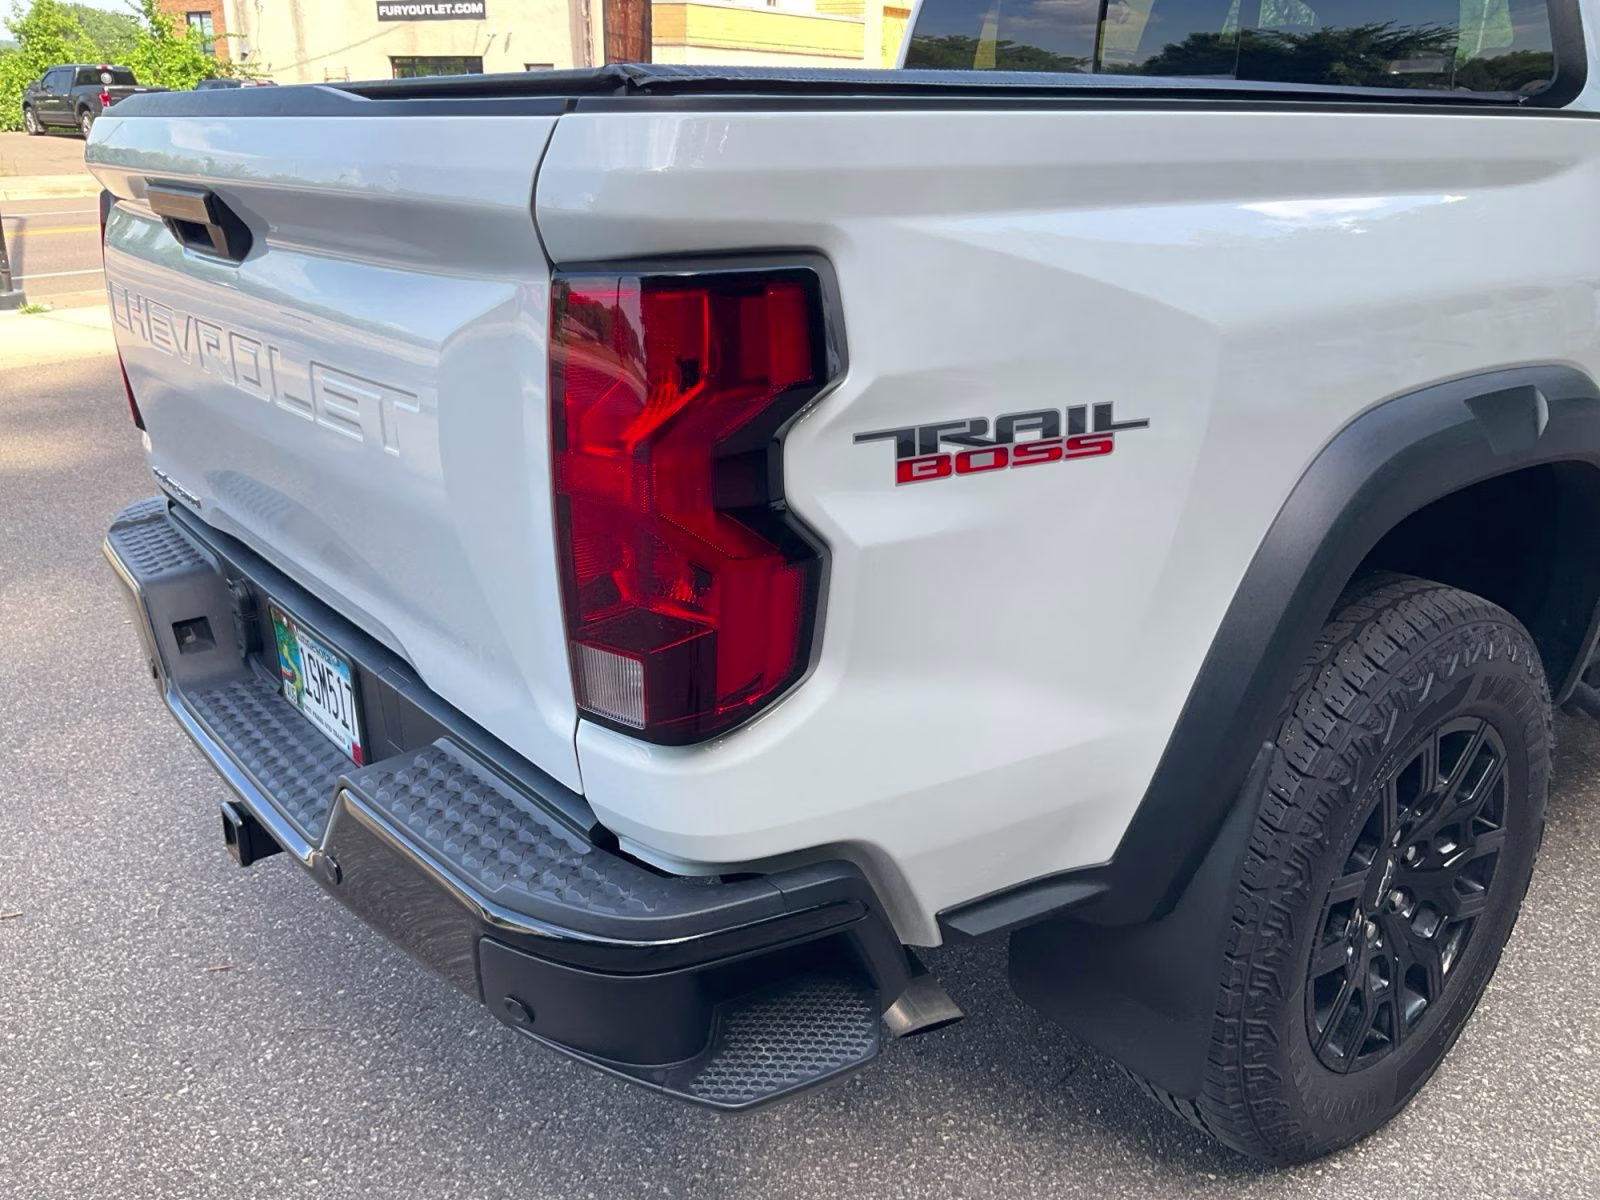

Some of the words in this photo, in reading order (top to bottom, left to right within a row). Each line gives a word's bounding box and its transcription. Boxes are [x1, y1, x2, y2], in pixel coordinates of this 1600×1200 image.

[379, 3, 483, 16] FURYOUTLET.COM
[108, 281, 420, 457] CHEVROLET
[852, 401, 1150, 459] TRAIL
[895, 431, 1115, 487] BOSS
[300, 647, 355, 736] 1SM517
